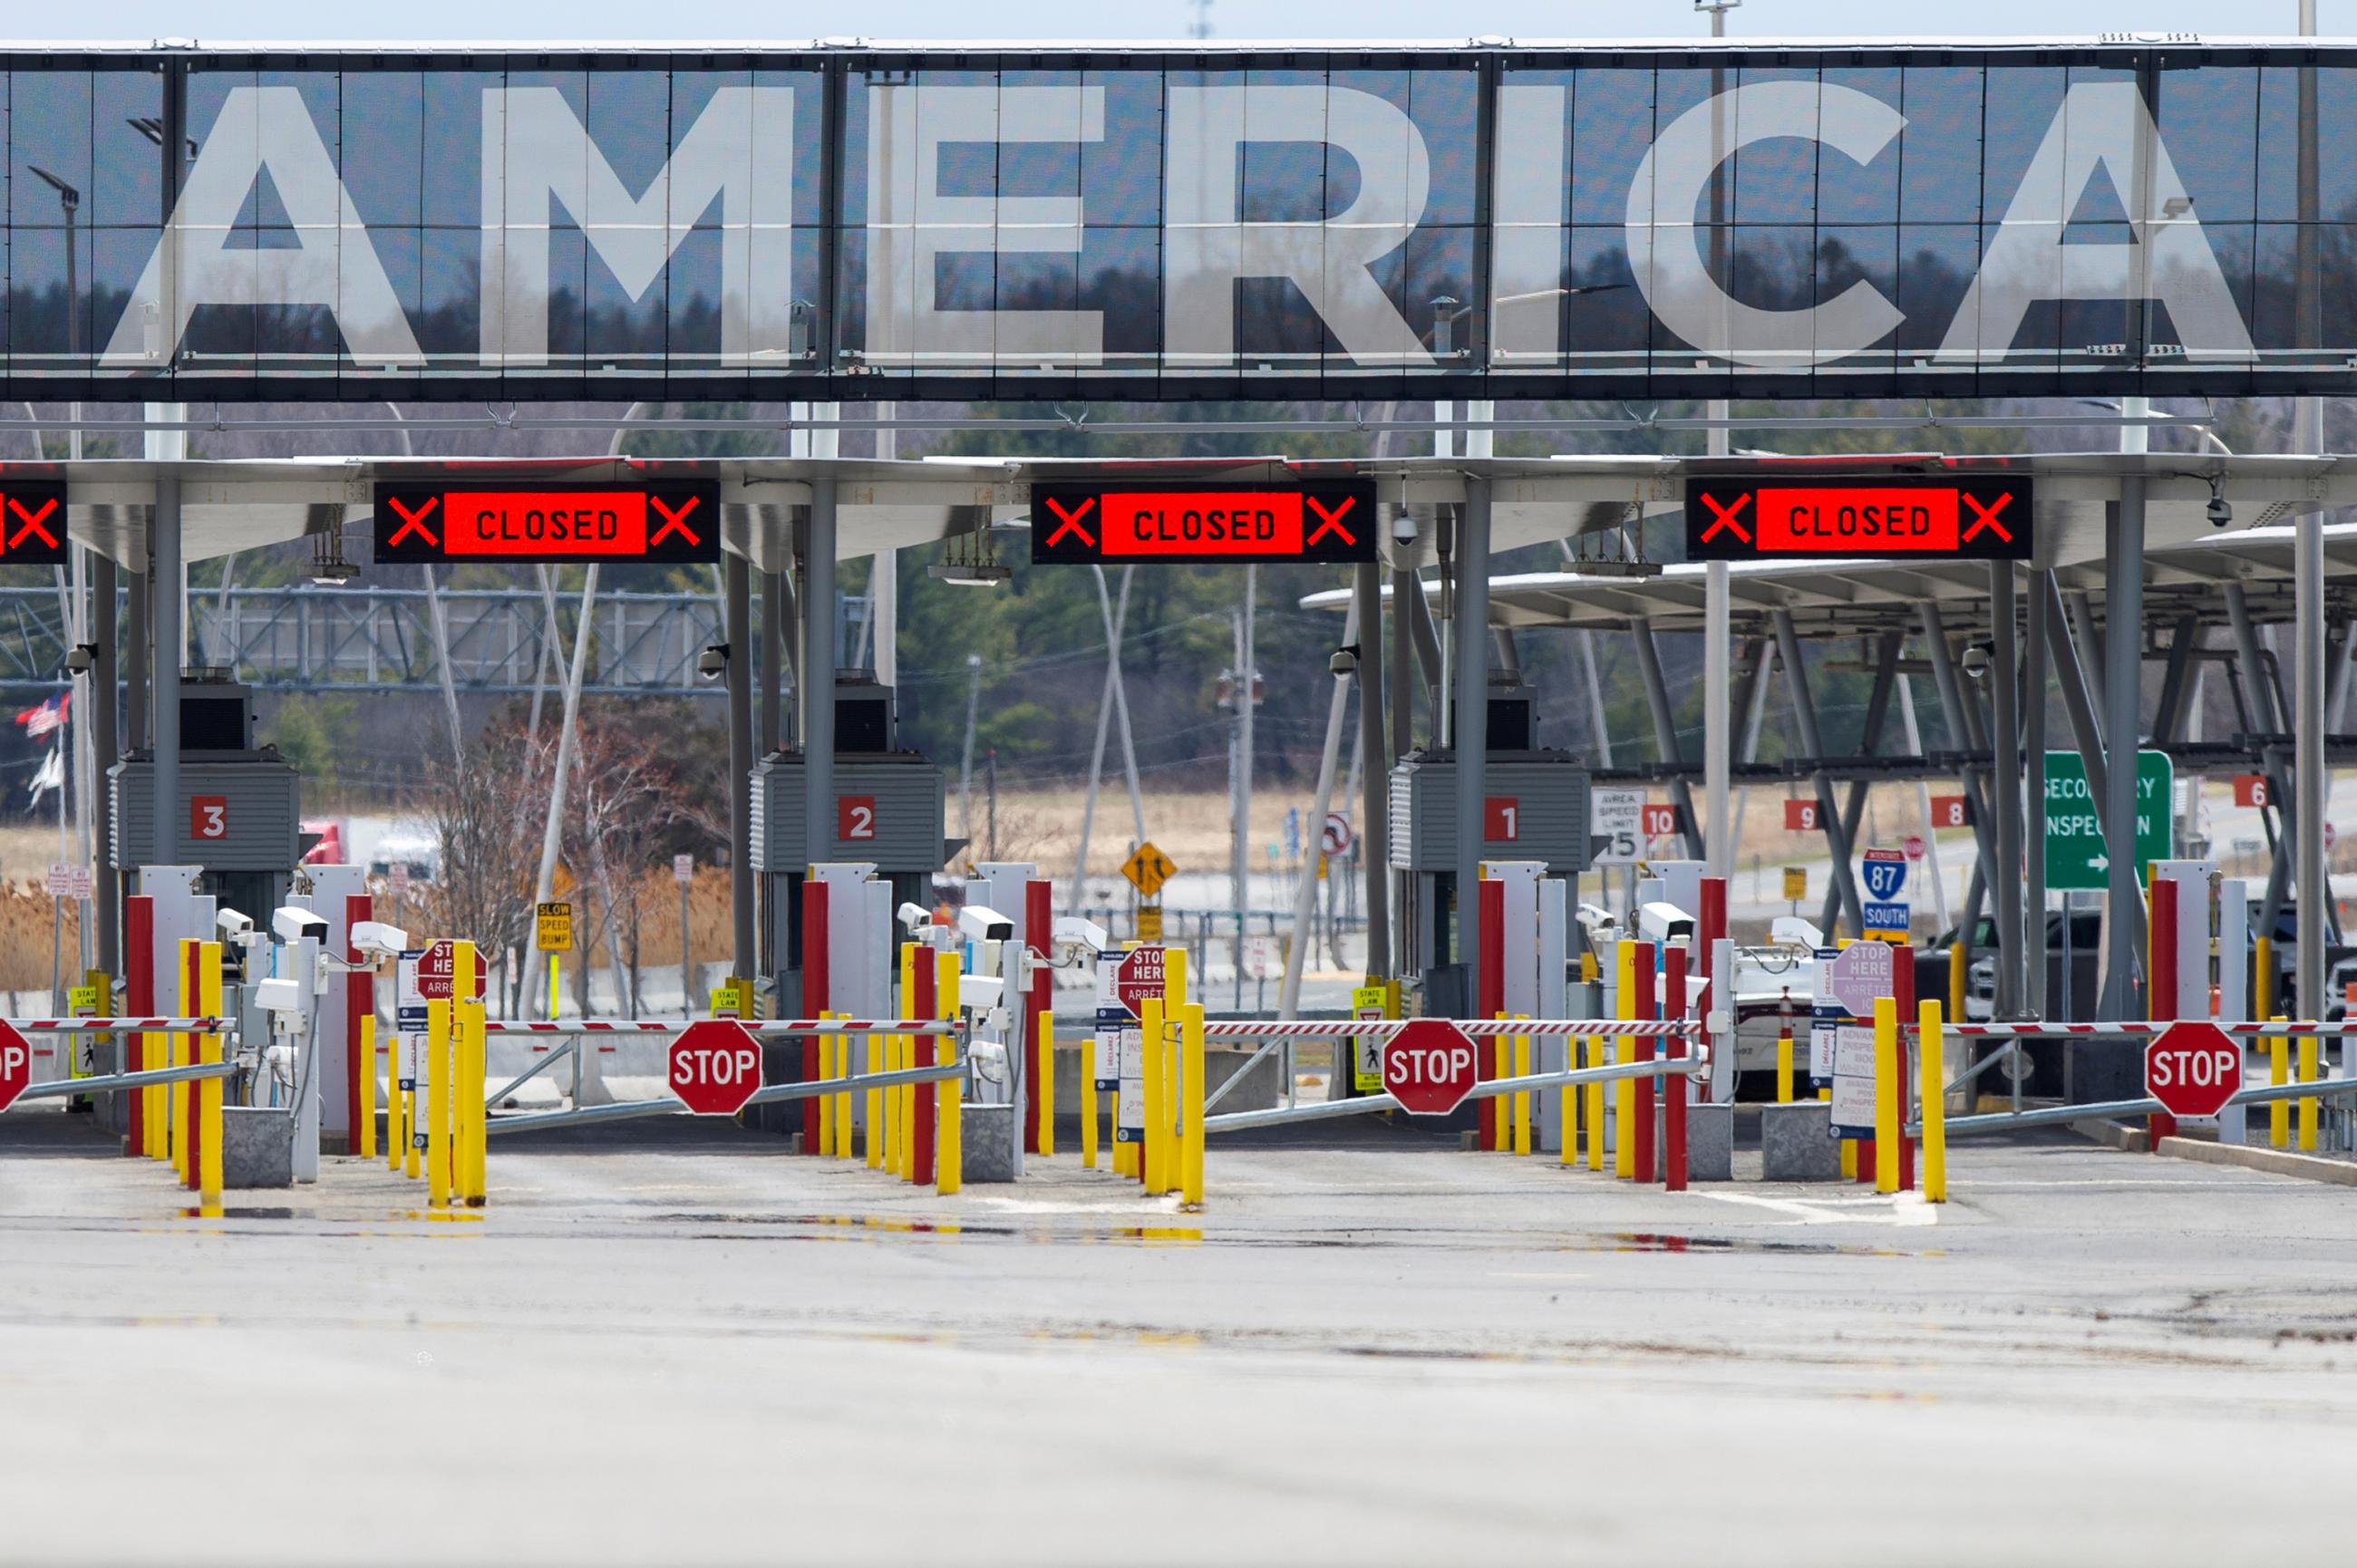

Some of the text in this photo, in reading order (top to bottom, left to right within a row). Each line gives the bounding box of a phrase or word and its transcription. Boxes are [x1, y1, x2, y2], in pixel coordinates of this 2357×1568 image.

[97, 80, 2260, 368] AMERICA
[476, 509, 617, 541] CLOSED
[1133, 509, 1275, 541] CLOSED
[1789, 505, 1930, 537] CLOSED
[2252, 782, 2265, 806] 6
[203, 806, 224, 837] 3
[850, 806, 872, 837] 2
[1501, 807, 1515, 838] 1
[1648, 810, 1673, 834] 10
[1800, 807, 1814, 828] 9
[1949, 802, 1963, 826] 8
[1870, 866, 1897, 892] 87
[539, 904, 570, 915] SLOW
[1866, 908, 1908, 925] SOUTH
[539, 919, 569, 931] SPEED
[434, 944, 452, 958] ST
[540, 934, 568, 944] BUMP
[1850, 946, 1887, 960] STOP
[433, 959, 452, 973] HE
[1850, 961, 1888, 975] HERE
[76, 990, 95, 998] STAT
[1128, 986, 1165, 1001] ARRÊT
[1360, 989, 1381, 998] STATE
[1861, 998, 1873, 1010] IC
[674, 1050, 755, 1085] STOP
[1389, 1049, 1470, 1084] STOP
[2152, 1050, 2236, 1086] STOP
